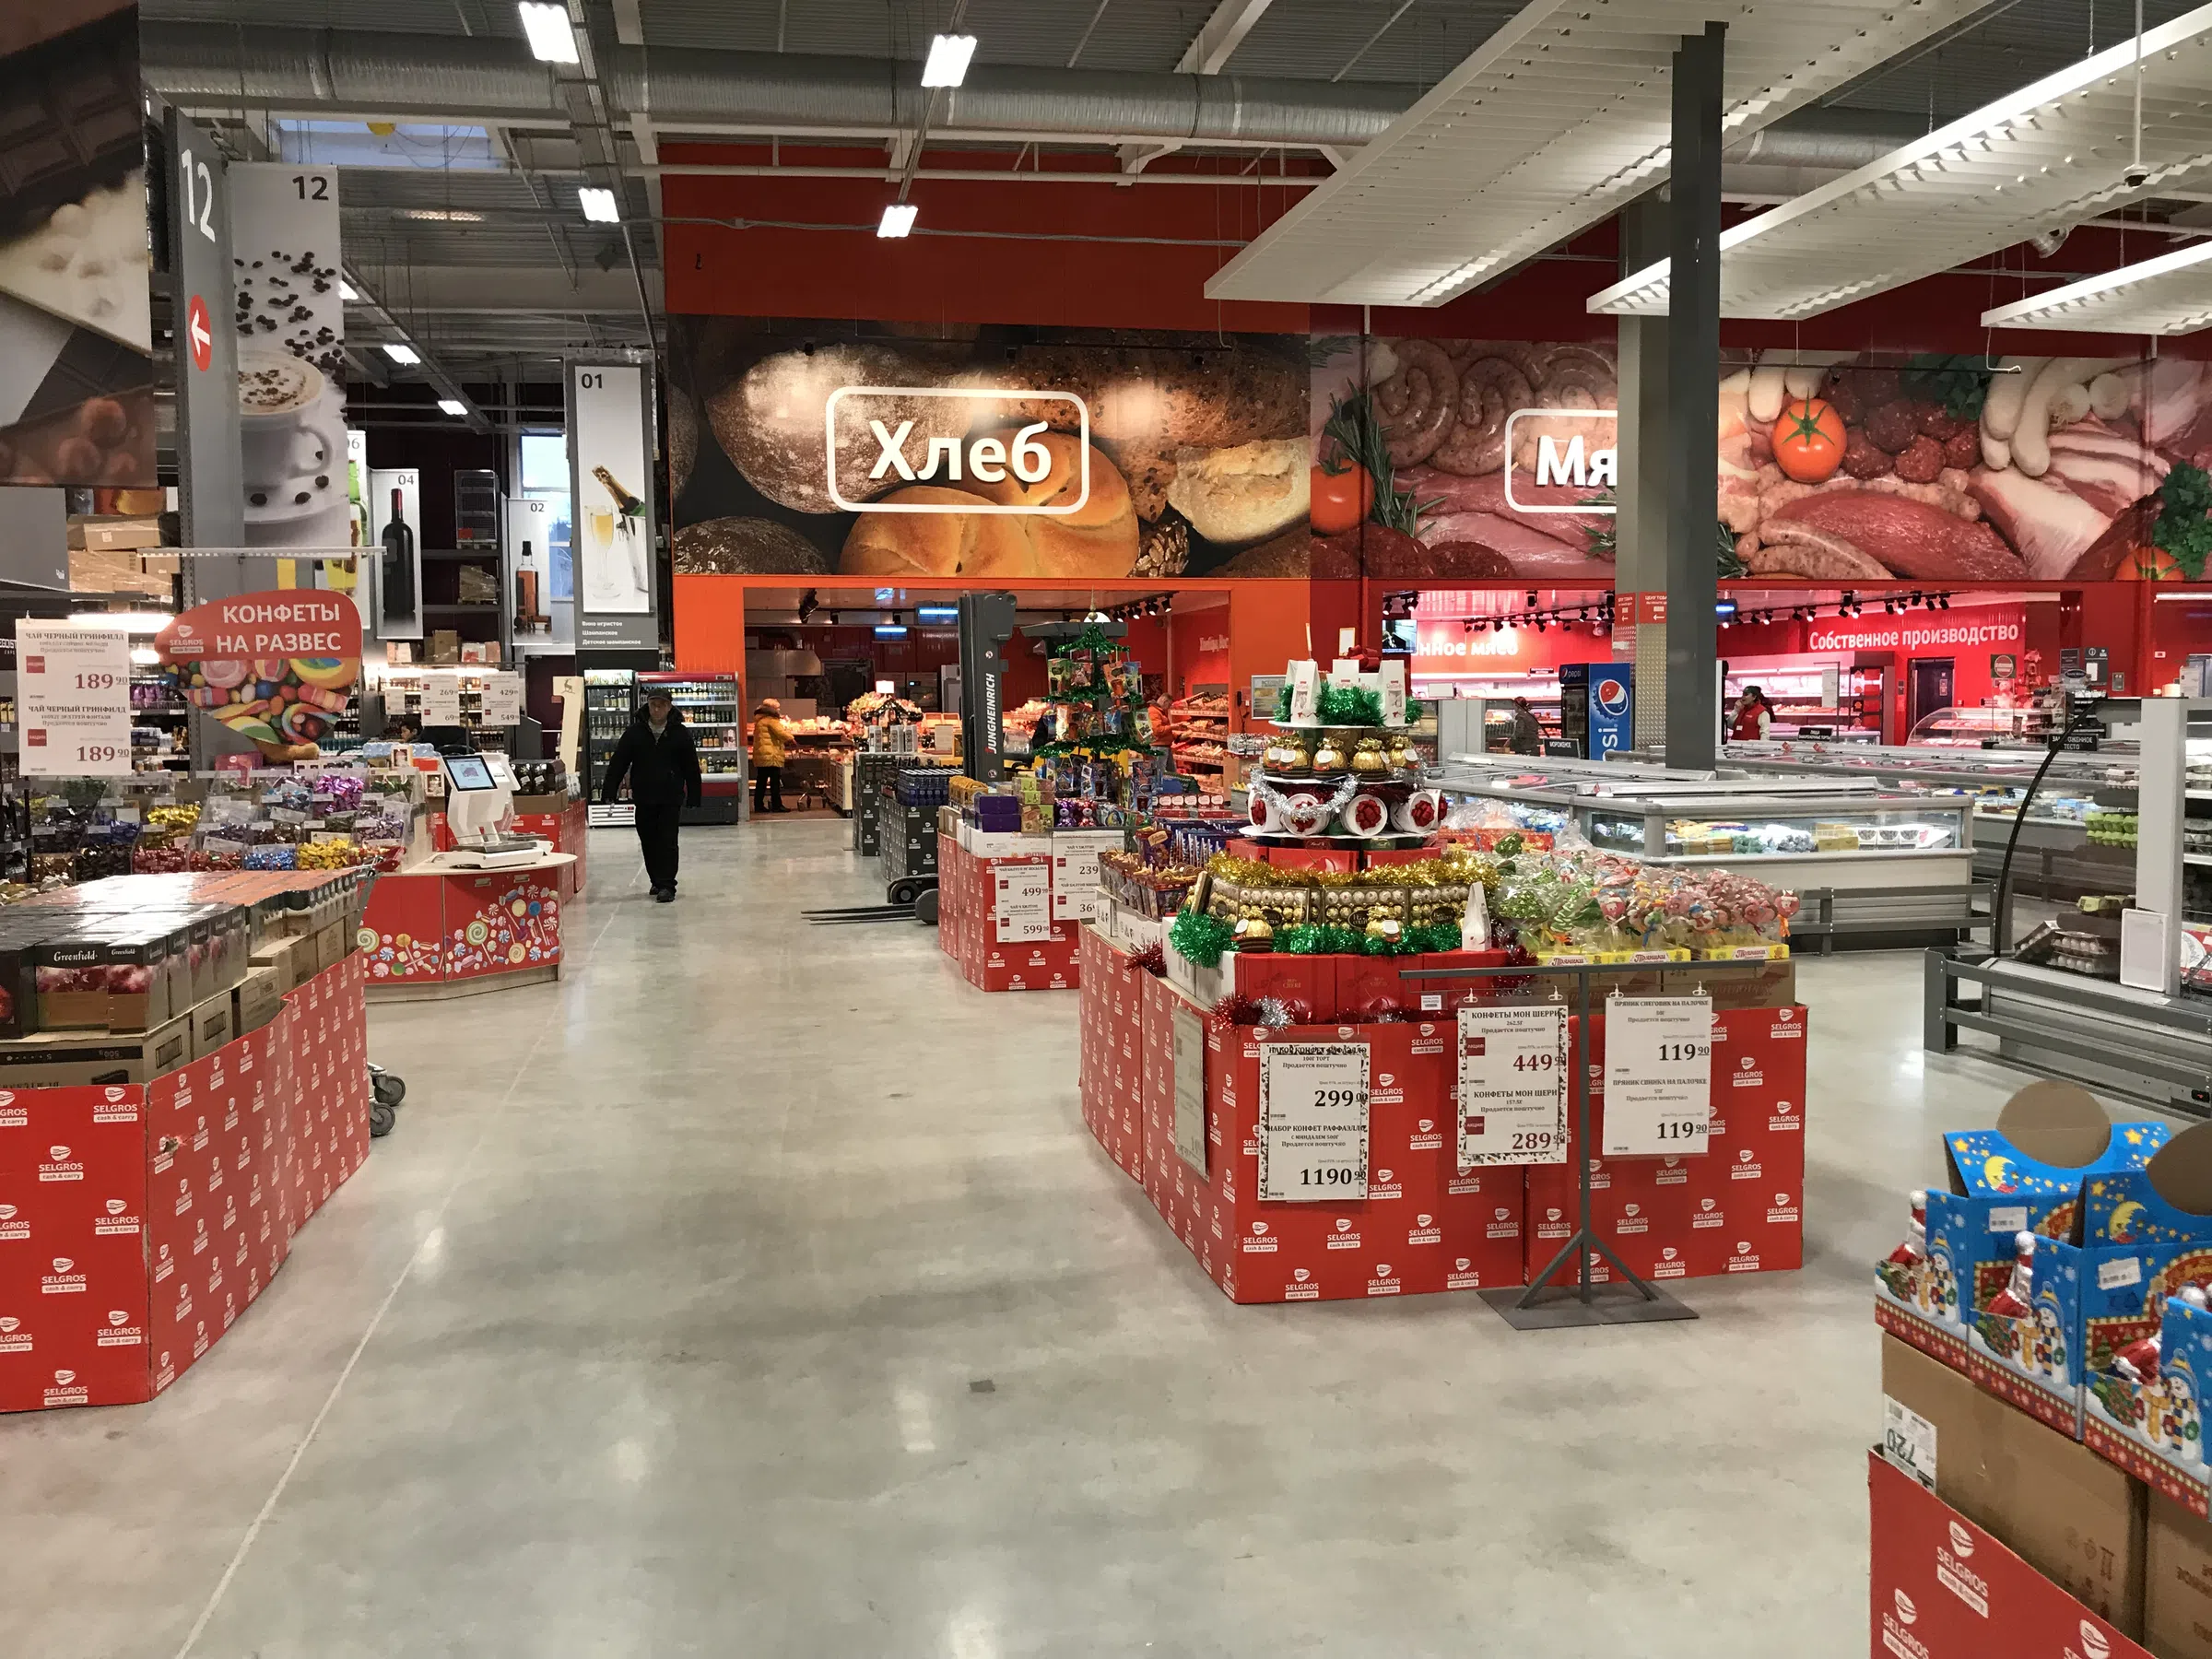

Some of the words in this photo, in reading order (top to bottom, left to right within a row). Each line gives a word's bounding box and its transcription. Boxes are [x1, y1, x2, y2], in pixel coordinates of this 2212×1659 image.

[292, 176, 329, 201] 12
[182, 149, 216, 242] 12
[581, 373, 603, 389] 01
[868, 420, 1052, 483] Хлеб
[1535, 435, 1618, 487] Мя
[397, 475, 414, 486] 04
[530, 502, 545, 512] 02
[223, 604, 340, 624] КОНФЕТЫ
[79, 632, 124, 641] ГРИНФИЛД
[1809, 630, 1899, 652] Собственное
[1902, 623, 2018, 651] производство
[170, 638, 204, 646] SELGROS
[216, 634, 253, 653] НА
[255, 632, 341, 653] РАЗВЕС
[1413, 642, 1466, 656] нное
[1568, 670, 1582, 678] pepsi
[75, 673, 113, 689] 189
[115, 677, 128, 685] 90
[81, 705, 126, 713] ГРИНФИЛД
[984, 673, 997, 754] JUNGHEINRICH
[76, 746, 115, 762] 189
[117, 749, 130, 758] 90
[1079, 866, 1099, 875] 239
[1021, 888, 1041, 897] 499
[1079, 903, 1095, 912] 36
[1023, 925, 1042, 935] 599
[53, 950, 96, 962] Greenfield
[1471, 1010, 1512, 1019] КОНФЕТЫ
[1512, 1010, 1531, 1018] МОН
[1532, 1009, 1559, 1018] ШЕРРИ
[1771, 1022, 1802, 1030] SELGROS
[1411, 1038, 1443, 1046] SELGROS
[1659, 1044, 1696, 1061] 119
[1697, 1046, 1710, 1055] 90
[1512, 1054, 1553, 1072] 449
[1733, 1070, 1763, 1079] SELGROS
[1370, 1088, 1404, 1096] SELGROS
[1474, 1090, 1513, 1099] КОНФЕТЫ
[1314, 1089, 1354, 1107] 299
[0, 1108, 28, 1116] GROS
[93, 1104, 137, 1113] SELGROS
[1657, 1122, 1694, 1139] 119
[1695, 1124, 1708, 1134] 90
[1409, 1133, 1442, 1142] SELGROS
[1512, 1133, 1551, 1150] 289
[39, 1162, 84, 1172] SELGROS
[1731, 1163, 1762, 1172] SELGROS
[1300, 1168, 1352, 1185] 1190
[1448, 1177, 1480, 1186] SELGROS
[1369, 1182, 1402, 1192] SELGROS
[1767, 1206, 1798, 1215] SELGROS
[95, 1216, 139, 1226] SELGROS
[1693, 1212, 1724, 1220] SELGROS
[1537, 1222, 1571, 1230] SELGROS
[1617, 1218, 1649, 1226] SELGROS
[1327, 1233, 1361, 1241] SELGROS
[1408, 1228, 1441, 1237] SELGROS
[1242, 1236, 1277, 1244] SELGROS
[1729, 1254, 1759, 1264] SELGROS
[41, 1274, 87, 1284] SELGROS
[1447, 1272, 1479, 1281] SELGROS
[1285, 1283, 1319, 1291] SELGROS
[1367, 1277, 1401, 1287] SELGROS
[97, 1327, 141, 1336] SELGROS
[43, 1386, 88, 1396] SELGROS
[1936, 1546, 1989, 1598] SELGROS
